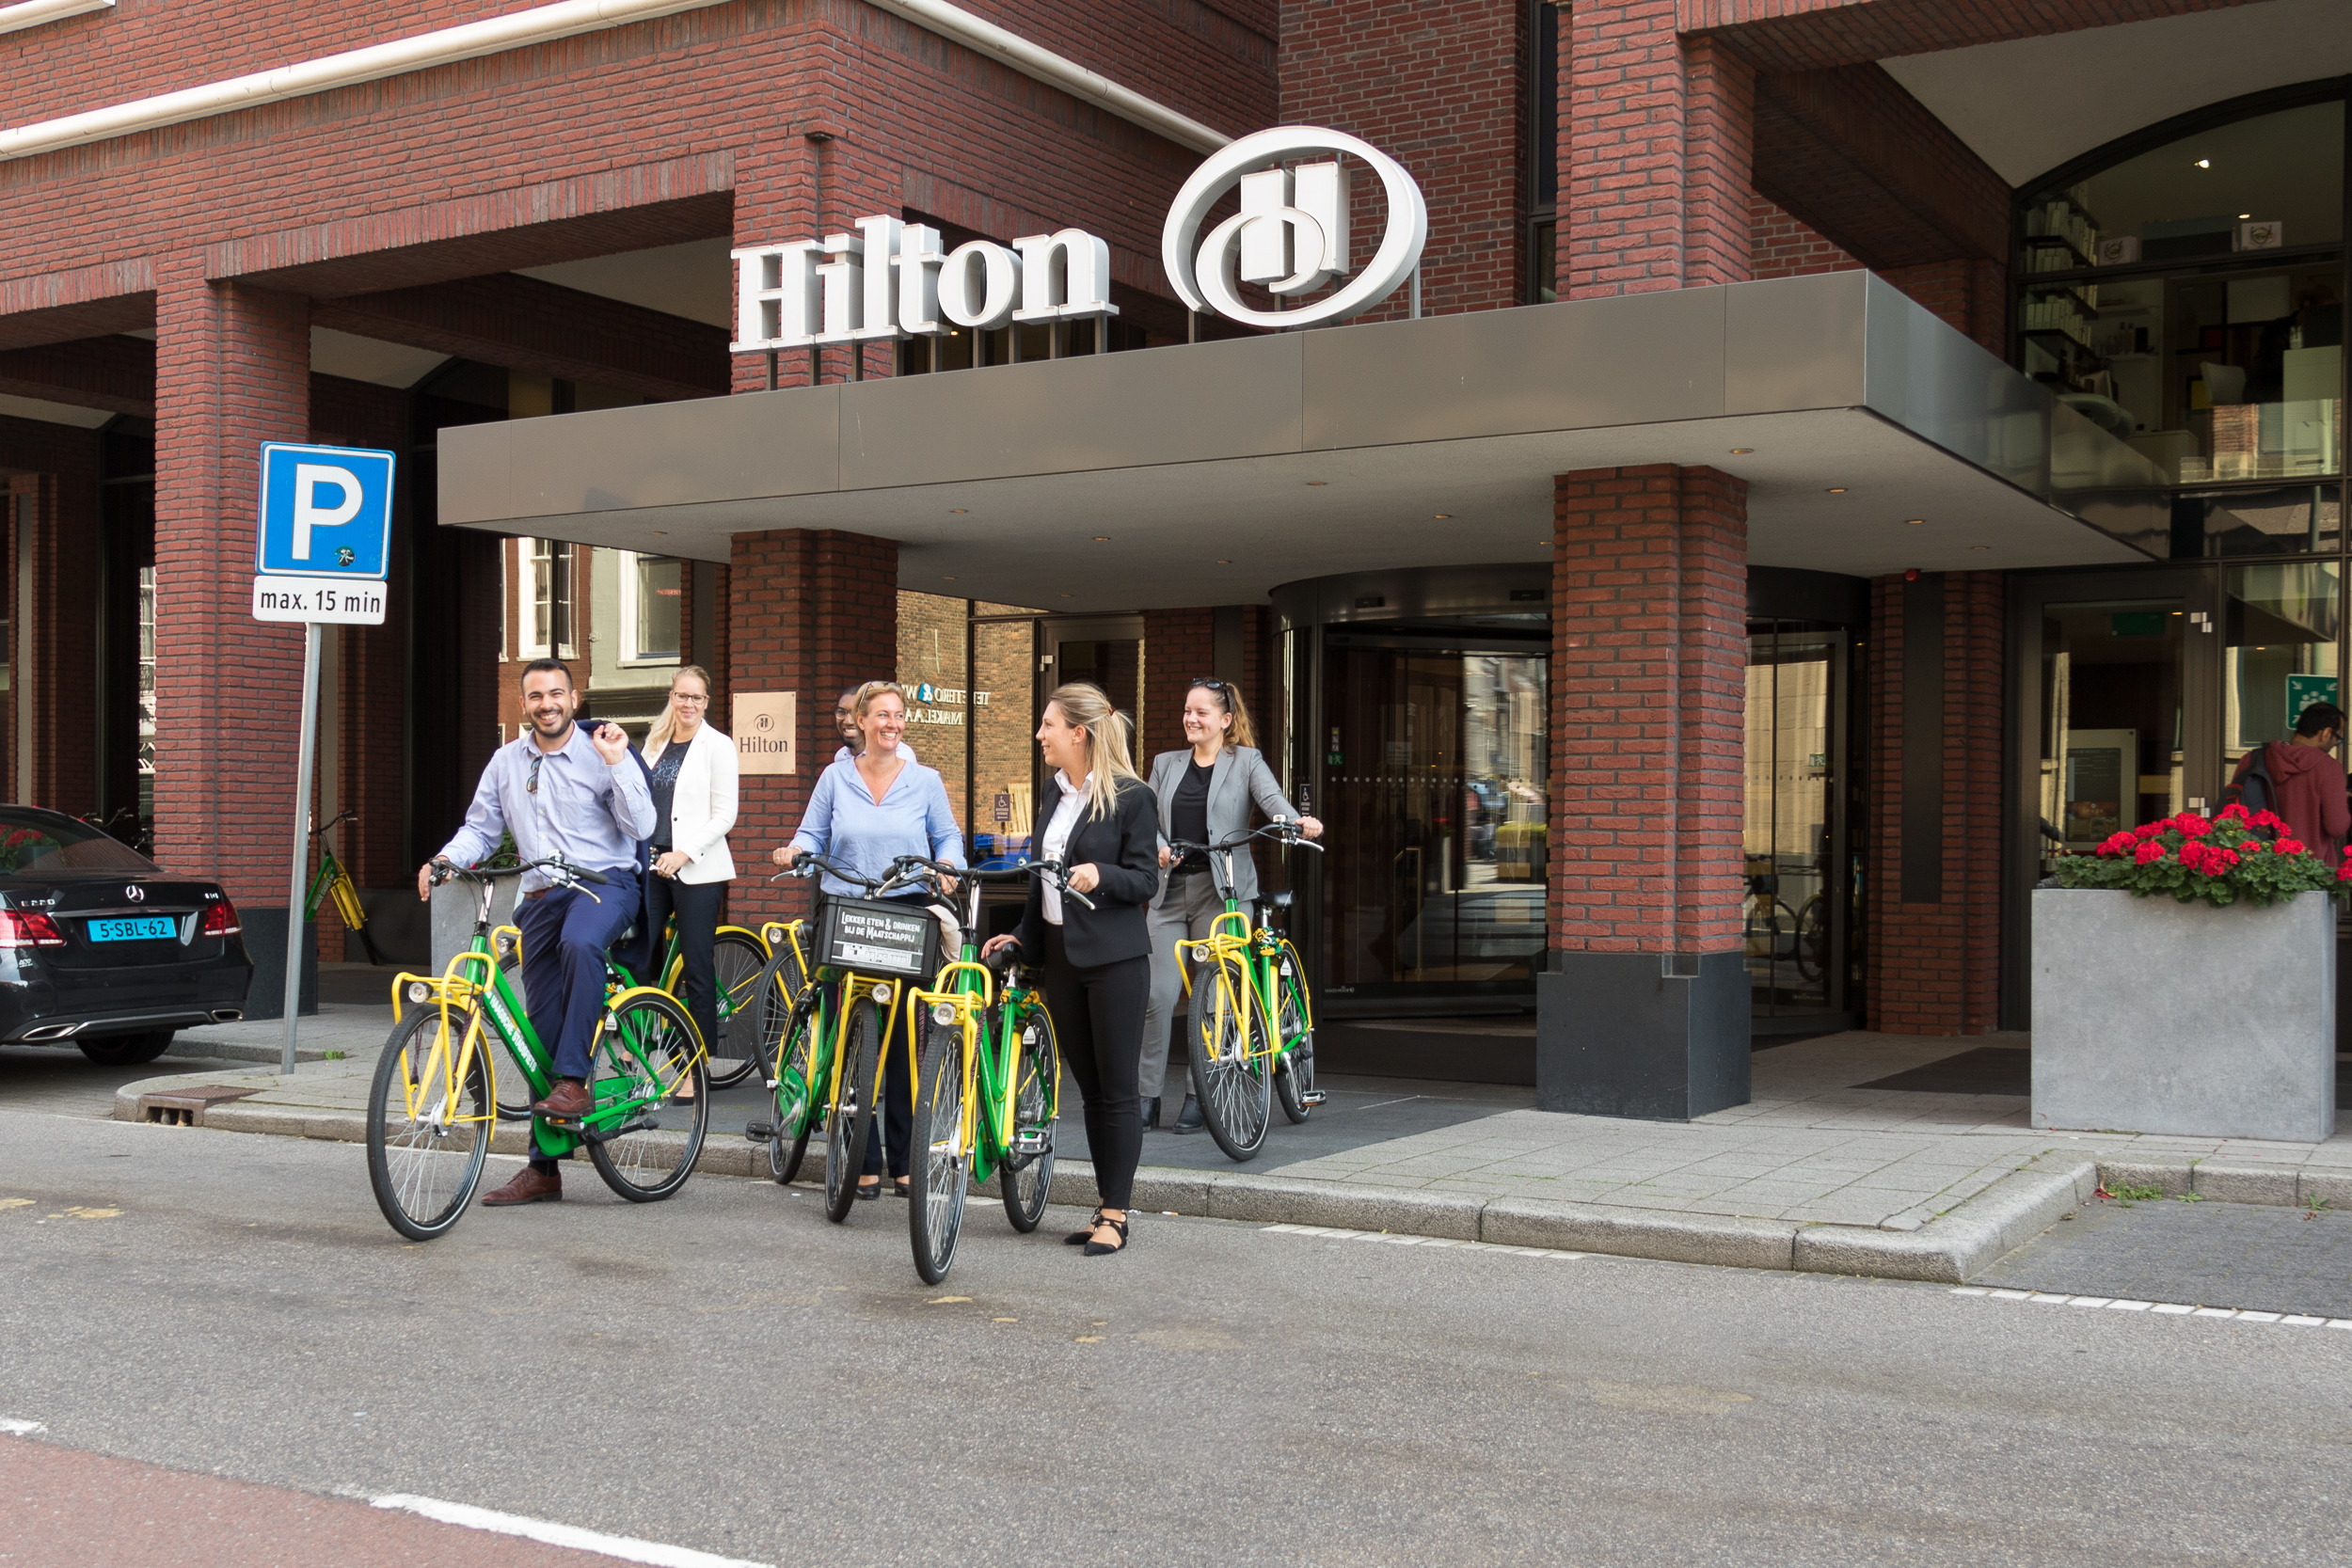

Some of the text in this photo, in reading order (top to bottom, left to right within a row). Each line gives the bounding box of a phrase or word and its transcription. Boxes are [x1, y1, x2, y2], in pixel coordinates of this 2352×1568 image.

[730, 214, 1120, 353] Hilton
[291, 463, 364, 561] P
[261, 590, 380, 612] max. 15 min
[739, 736, 788, 752] Hilton
[100, 920, 167, 939] 5-SBL-62
[841, 911, 920, 932] LEKKER ETEN & DRINKEN
[844, 925, 915, 942] BIJ DE MAATSCHAPPIJ
